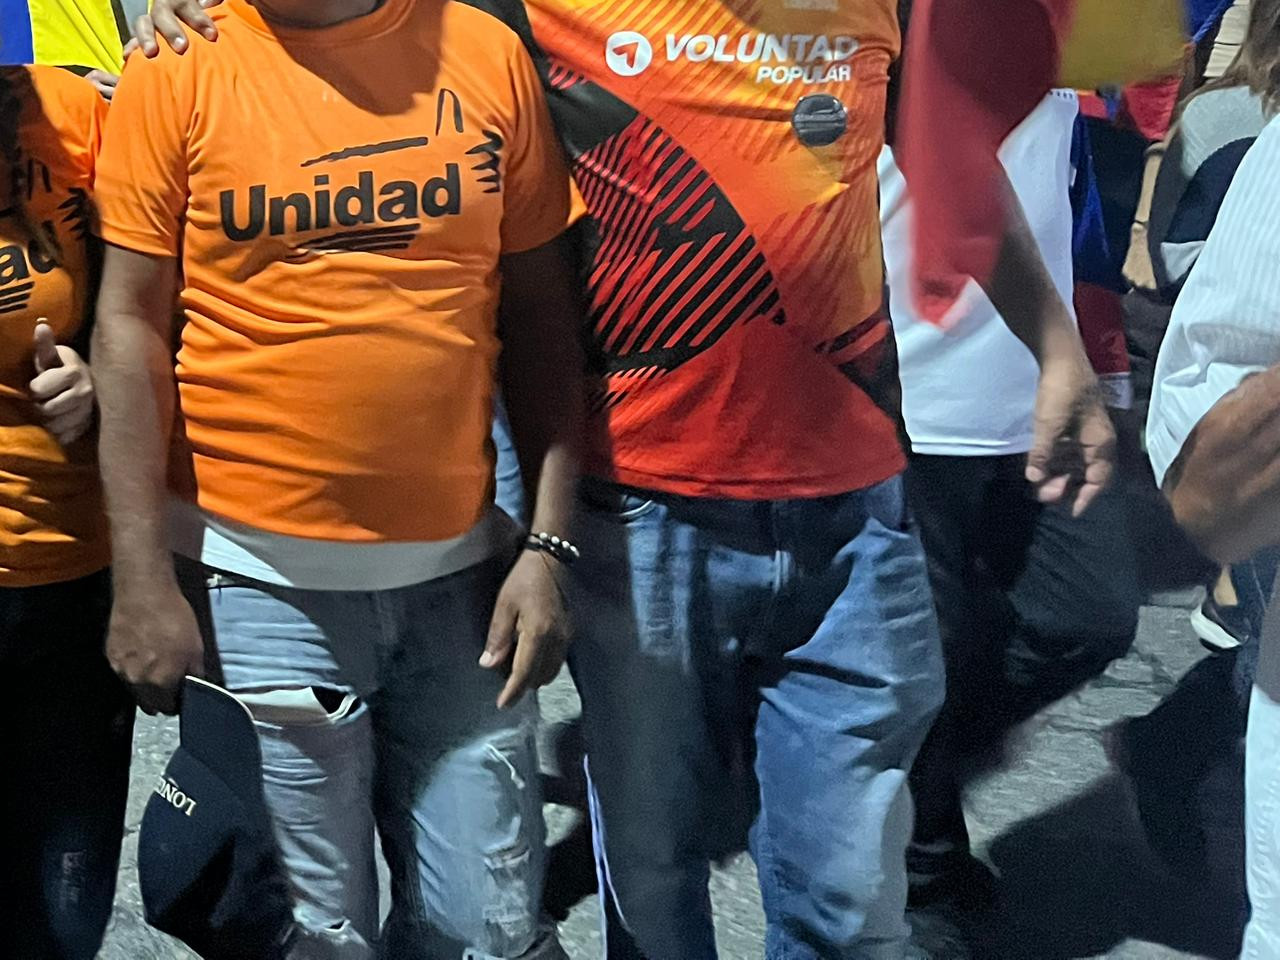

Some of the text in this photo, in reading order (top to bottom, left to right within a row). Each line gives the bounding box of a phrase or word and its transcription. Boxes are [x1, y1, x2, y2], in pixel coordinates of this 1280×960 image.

[665, 33, 859, 63] VOLUNTAD
[755, 64, 852, 85] POPULAR
[220, 163, 461, 242] Unidad
